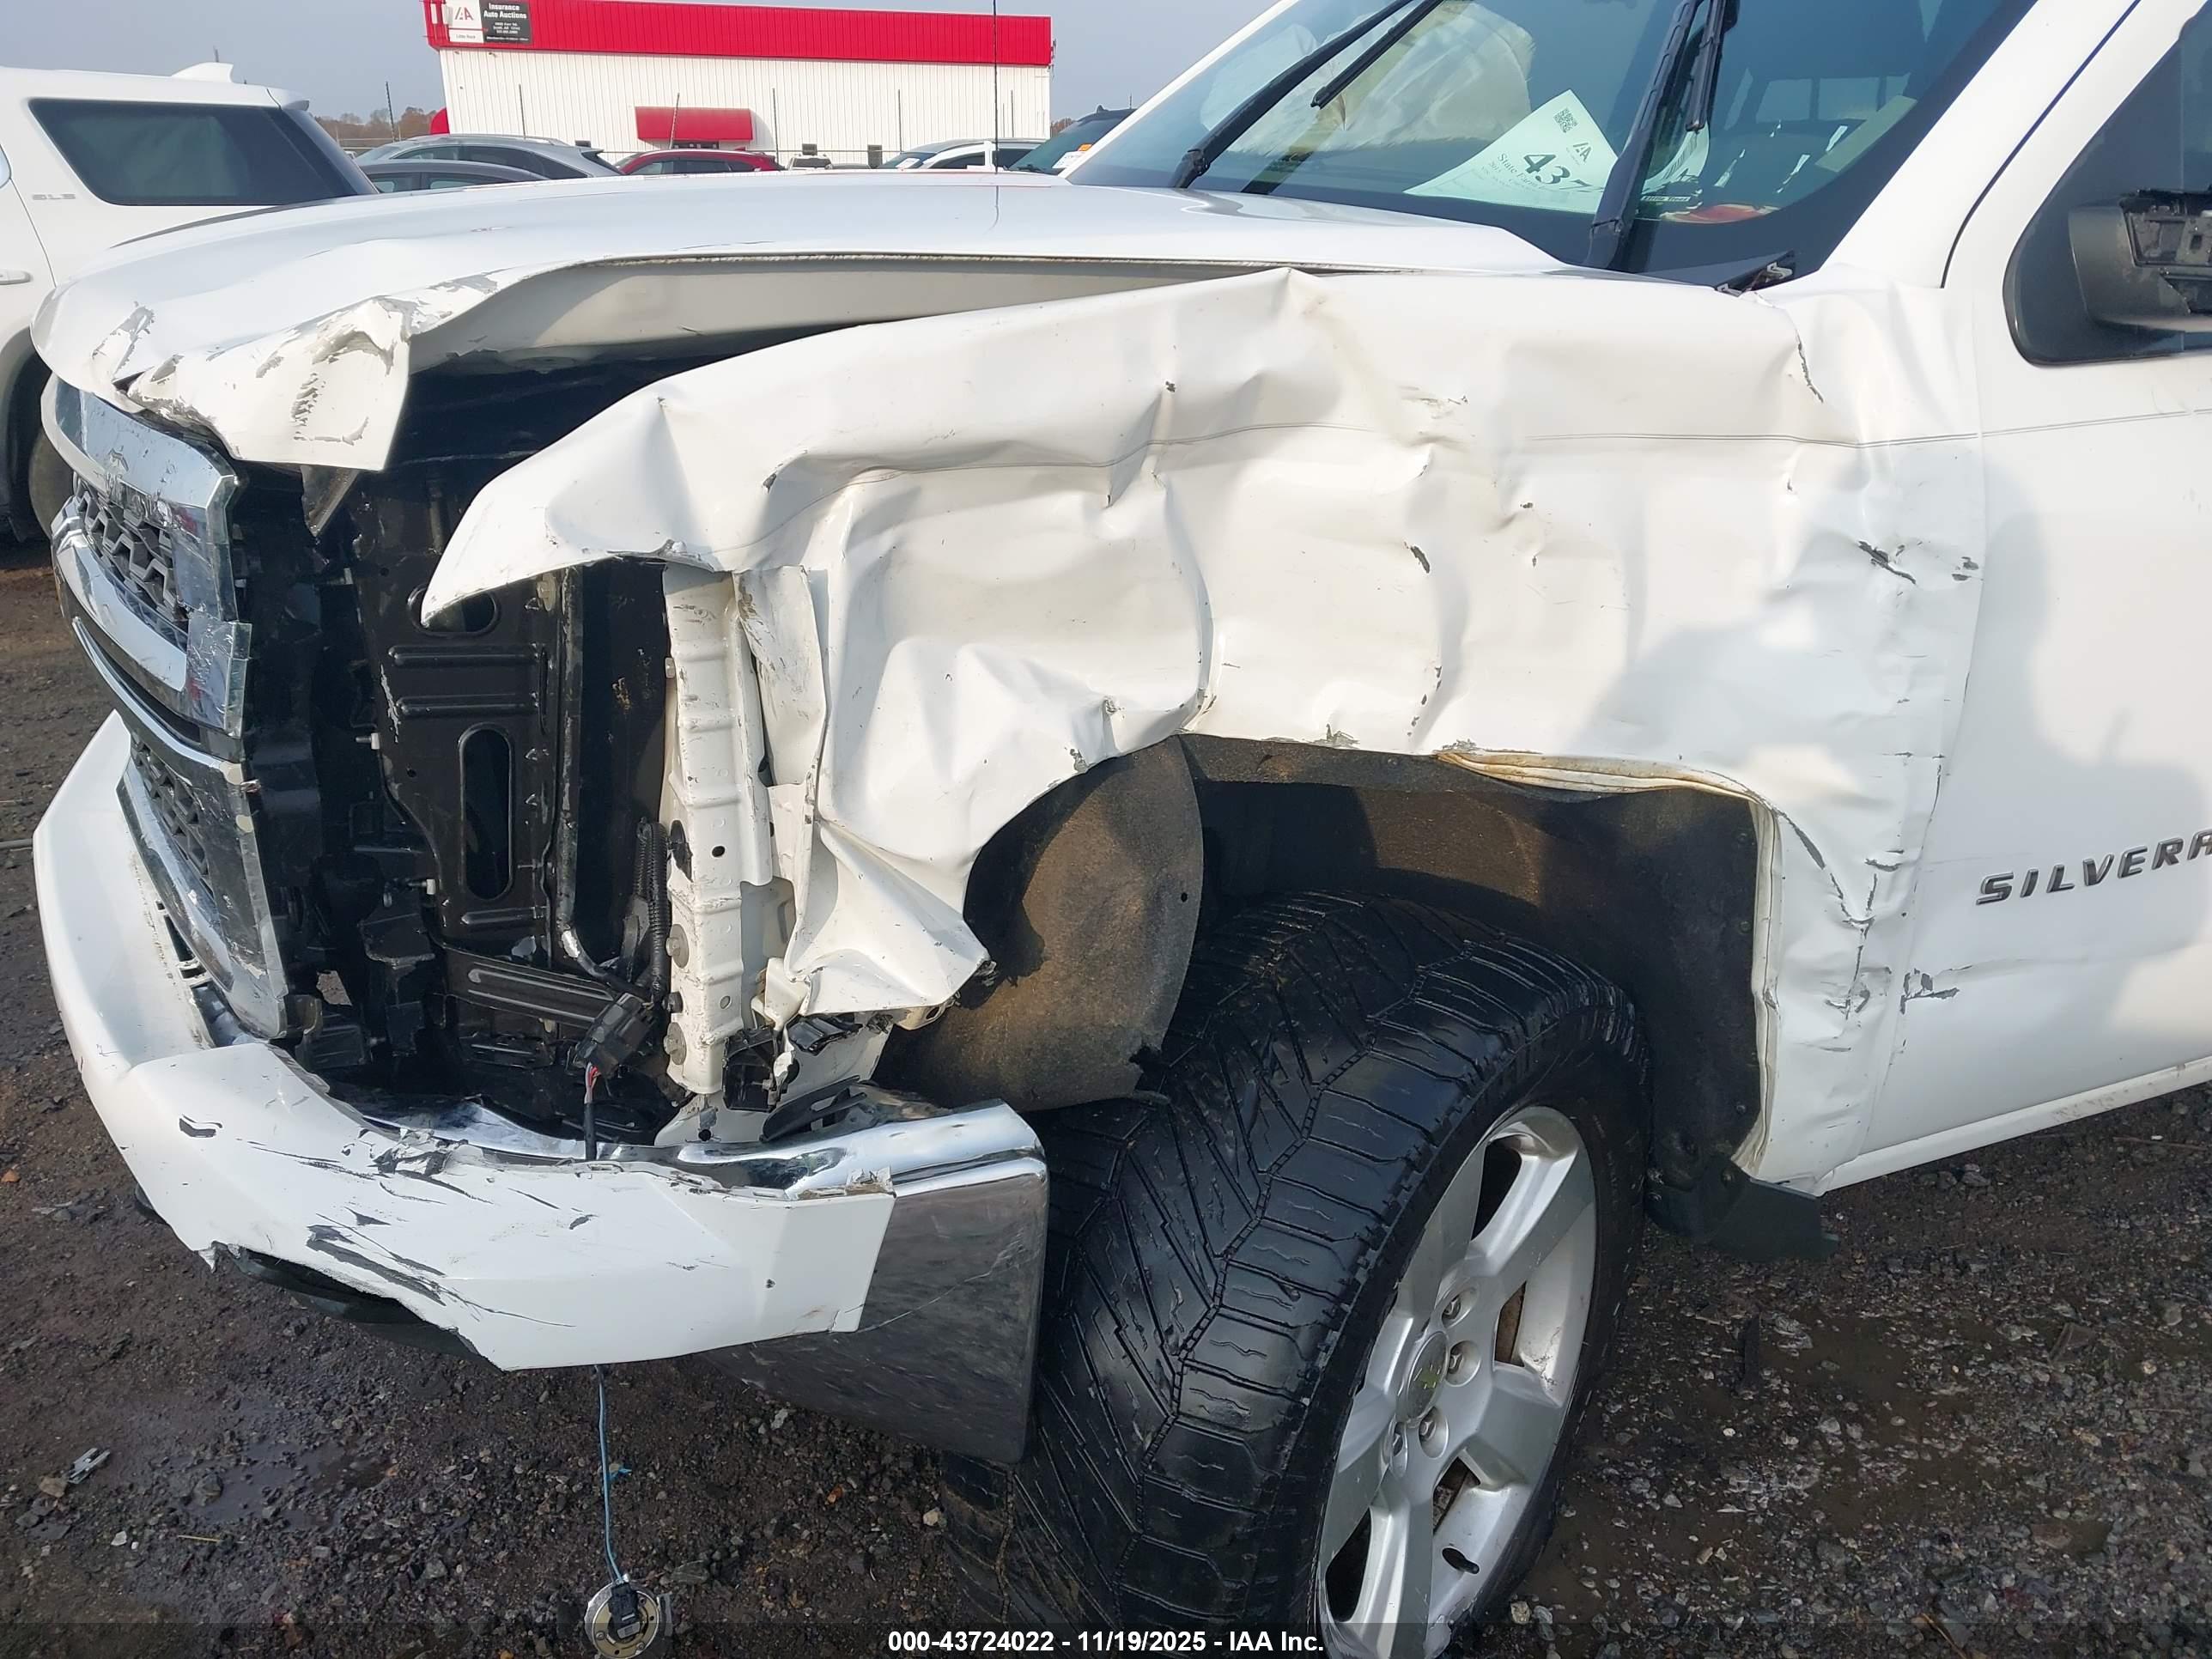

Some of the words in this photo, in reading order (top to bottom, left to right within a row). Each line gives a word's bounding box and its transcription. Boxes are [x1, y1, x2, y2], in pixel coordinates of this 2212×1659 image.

[489, 3, 520, 11] Insurance
[500, 10, 527, 19] Auctions
[1498, 153, 1518, 173] State
[1522, 153, 1605, 192] 437
[1976, 829, 2212, 905] SILVERA
